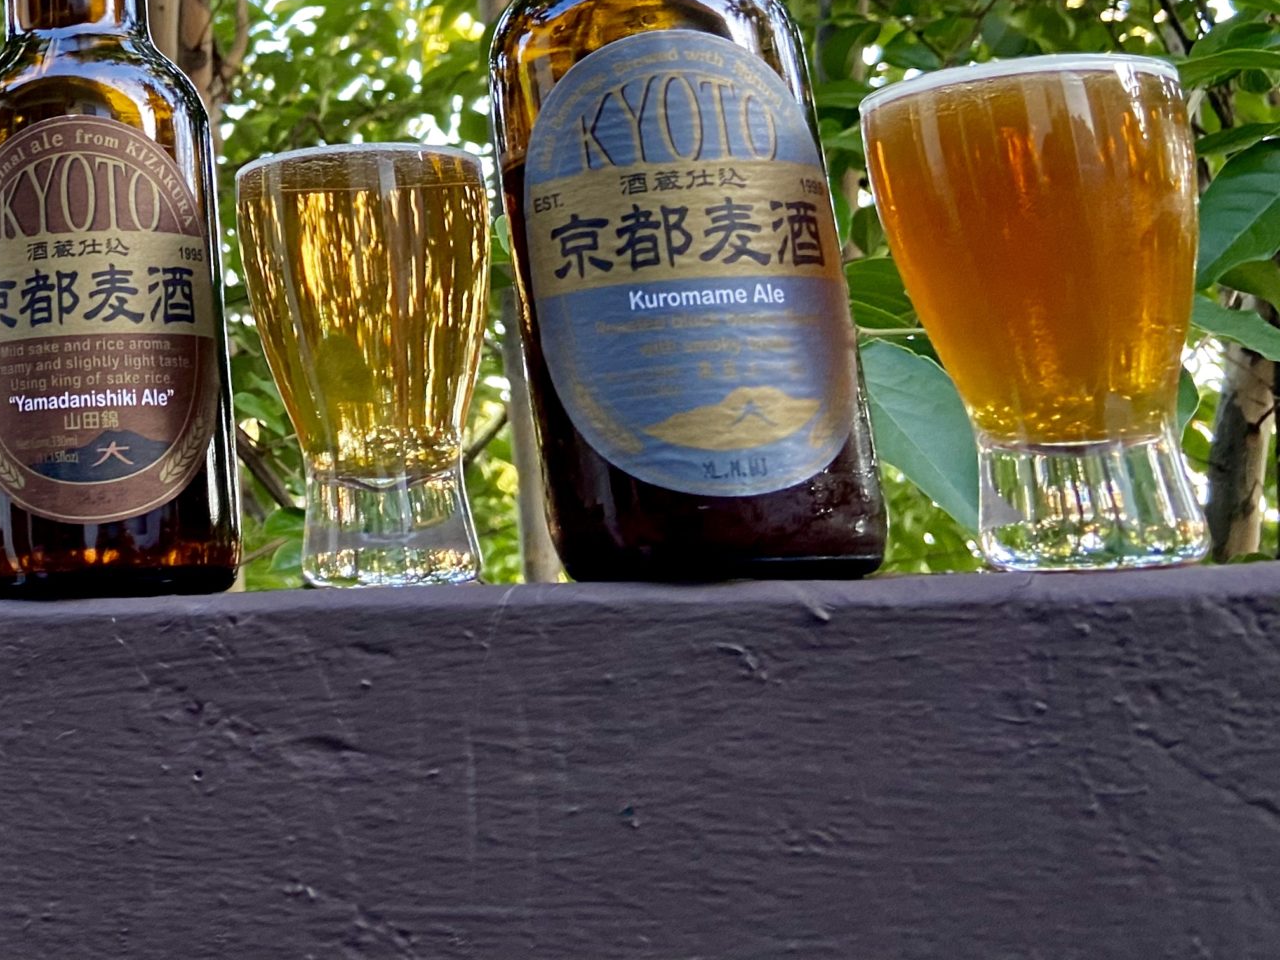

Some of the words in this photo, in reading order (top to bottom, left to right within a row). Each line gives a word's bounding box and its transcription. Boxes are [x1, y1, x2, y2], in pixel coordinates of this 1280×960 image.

[572, 71, 777, 169] KYOTO
[30, 132, 64, 154] ale
[75, 129, 119, 148] from
[125, 141, 195, 228] KIZAKURA
[0, 153, 160, 240] KYOTO
[533, 192, 564, 214] EST.
[551, 197, 825, 280] 京都麦酒
[178, 246, 203, 262] 1995
[629, 289, 747, 310] Kuromame
[754, 284, 785, 303] Ale
[0, 346, 24, 358] Mild
[28, 343, 60, 355] sake
[64, 339, 91, 352] and
[96, 338, 124, 350] rice
[36, 358, 61, 371] and
[66, 355, 120, 371] slightly
[124, 355, 155, 370] light
[10, 377, 47, 391] Using
[51, 375, 81, 390] king
[86, 372, 101, 385] of
[107, 372, 140, 385] sake
